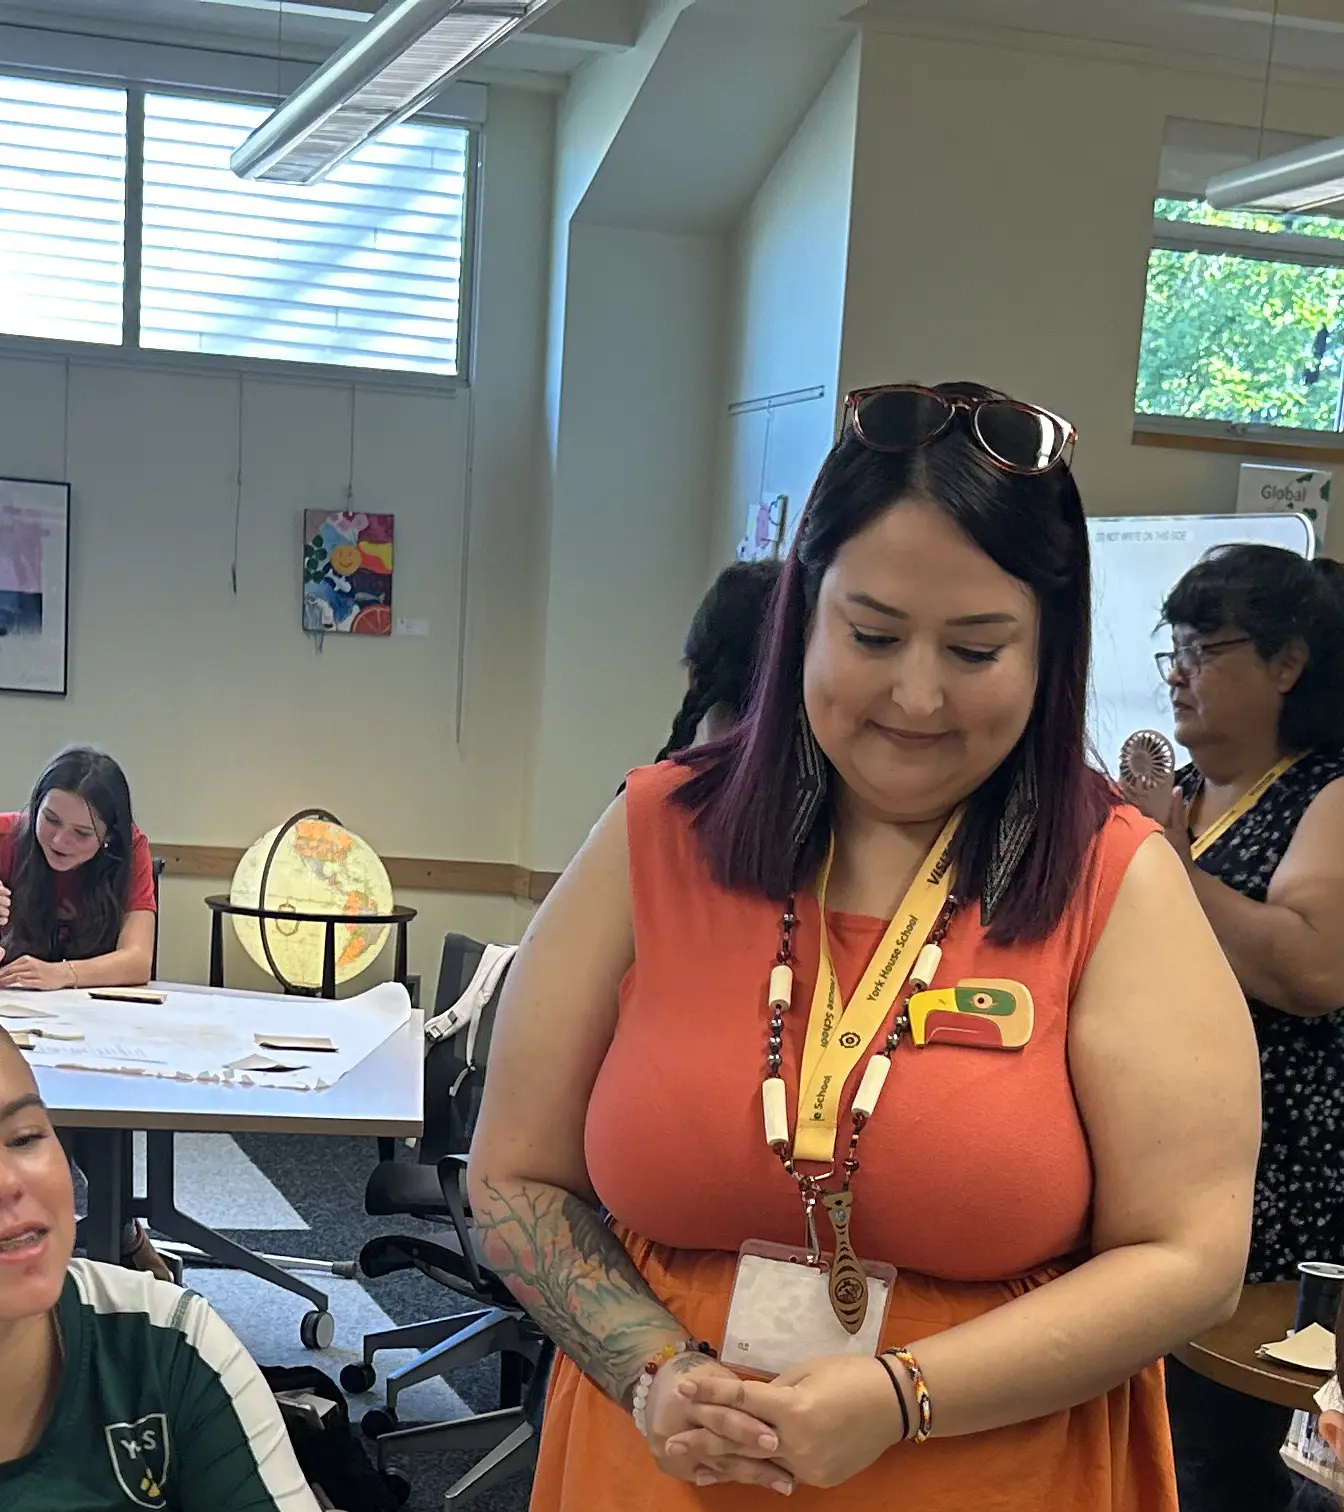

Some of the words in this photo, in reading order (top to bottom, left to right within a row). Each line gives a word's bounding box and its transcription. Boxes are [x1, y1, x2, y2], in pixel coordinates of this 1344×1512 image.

[1260, 484, 1306, 502] Global
[867, 971, 891, 1003] York
[881, 947, 902, 983] House
[896, 914, 919, 955] School
[814, 1075, 832, 1109] School
